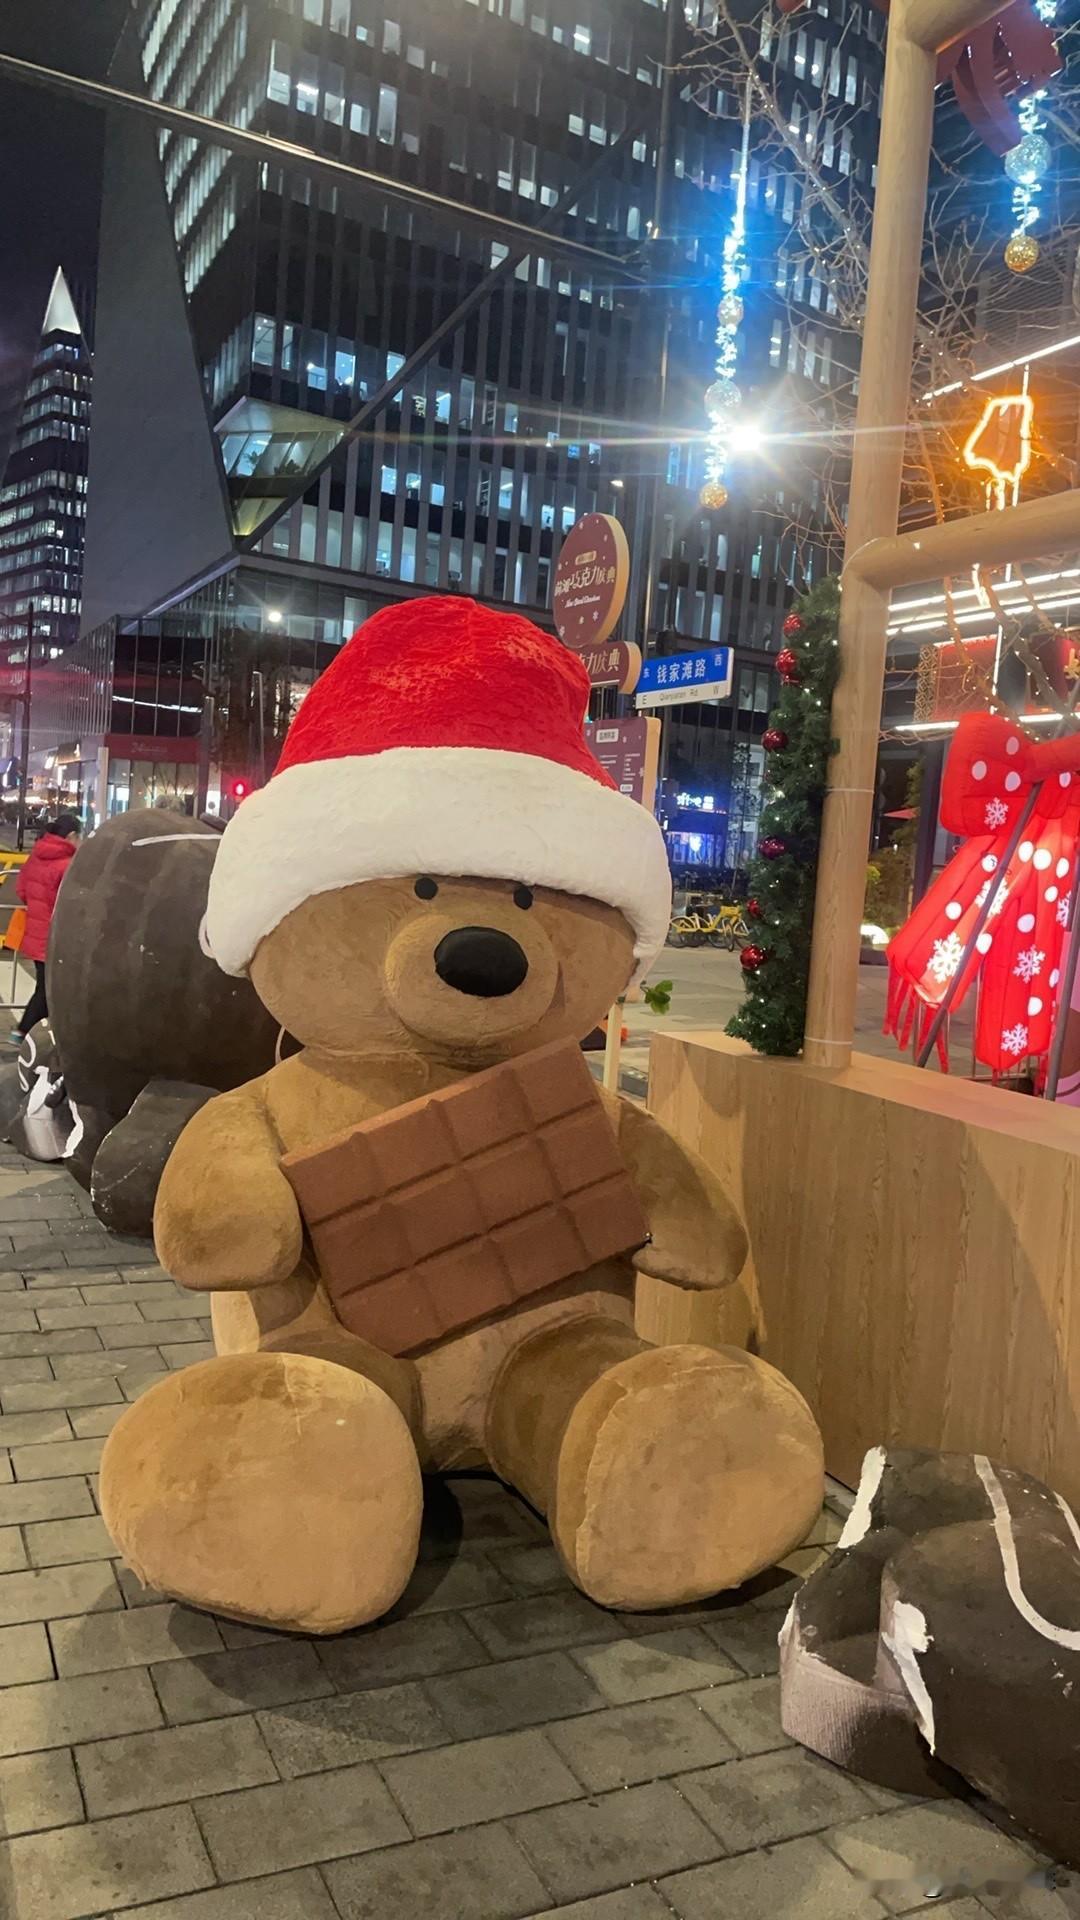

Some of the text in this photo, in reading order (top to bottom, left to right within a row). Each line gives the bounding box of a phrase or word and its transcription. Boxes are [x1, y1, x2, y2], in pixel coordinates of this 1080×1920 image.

[643, 654, 722, 684] 东 钱家滩路 西
[642, 695, 647, 705] E
[690, 688, 698, 696] Rd
